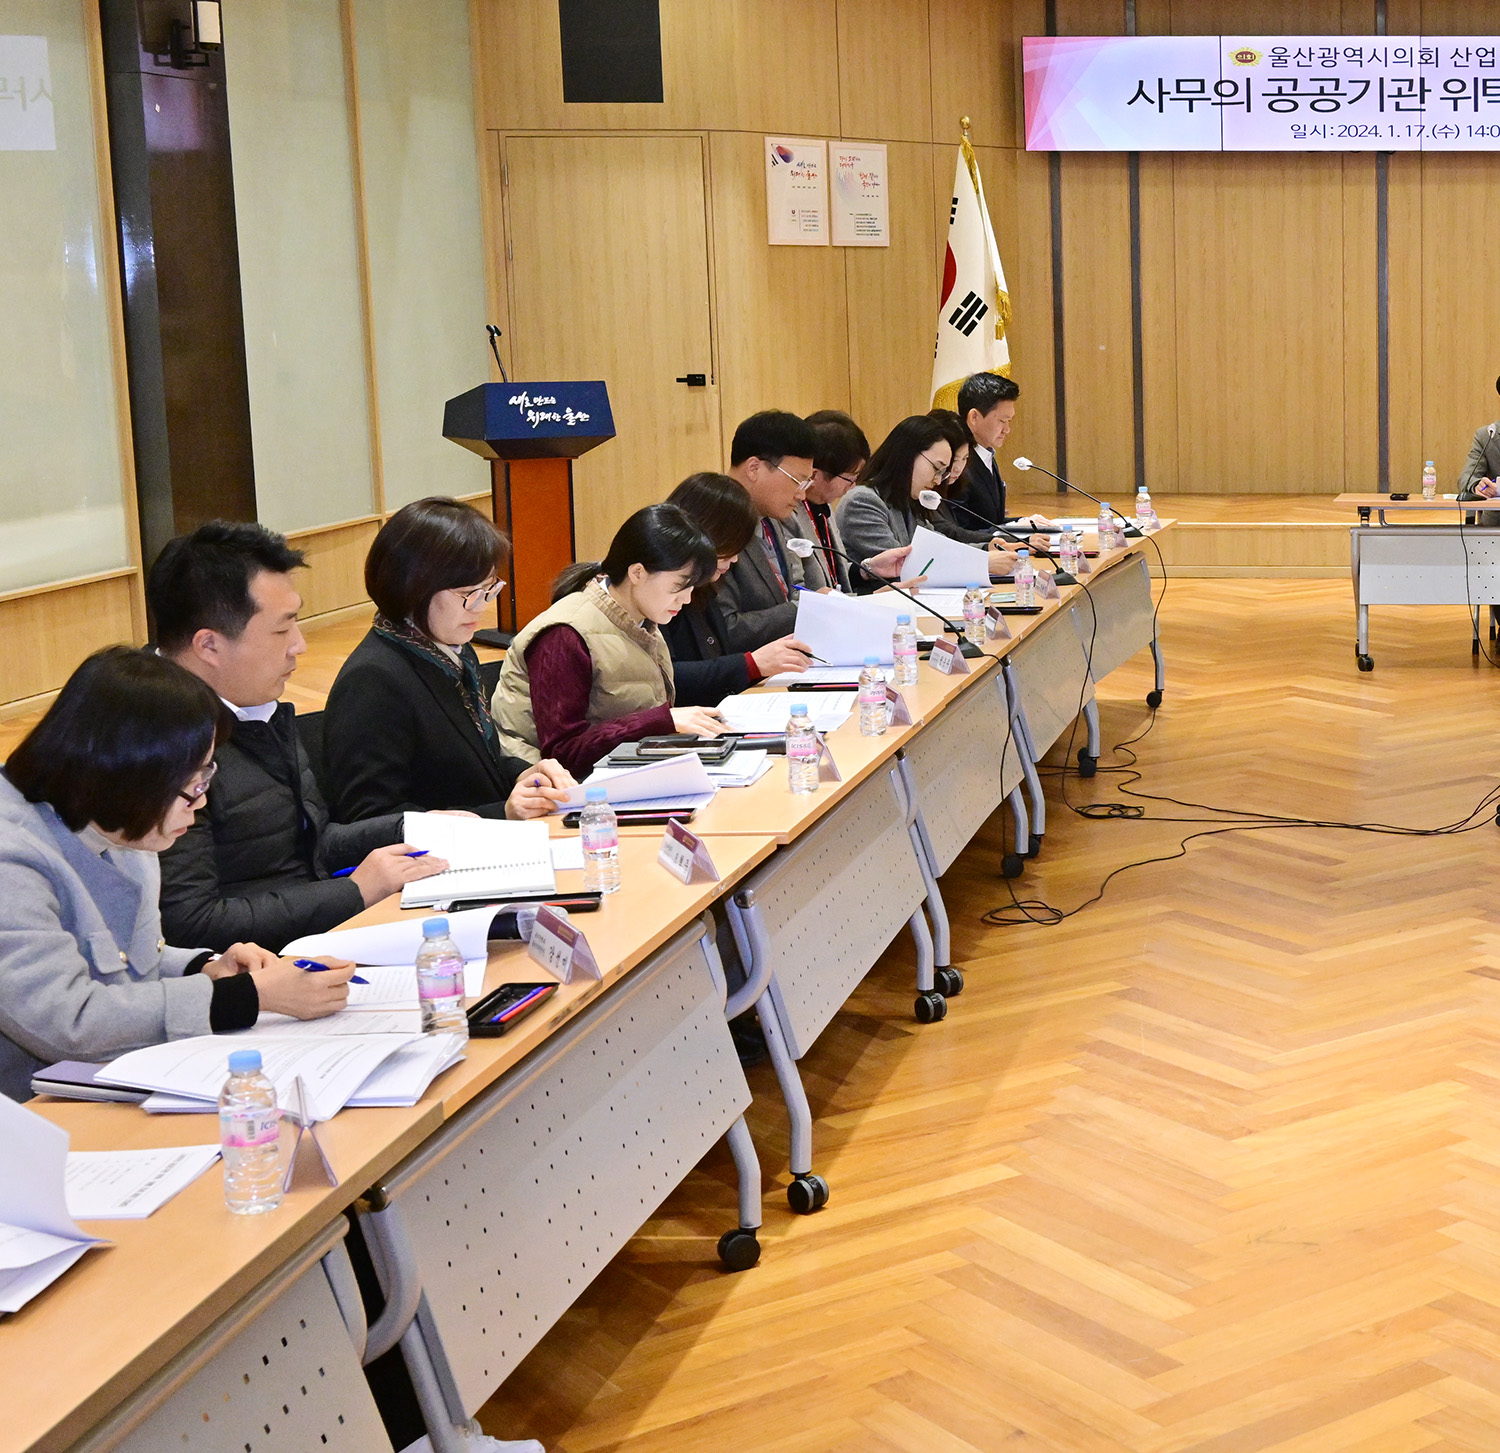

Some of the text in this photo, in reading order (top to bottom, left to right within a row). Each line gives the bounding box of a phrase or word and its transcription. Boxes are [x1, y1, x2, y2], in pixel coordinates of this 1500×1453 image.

[1268, 46, 1440, 69] 울산광역시의회
[1126, 77, 1252, 114] 사무의
[1261, 76, 1432, 114] 공공기관
[508, 391, 534, 414] 새로
[562, 406, 590, 426] 울산
